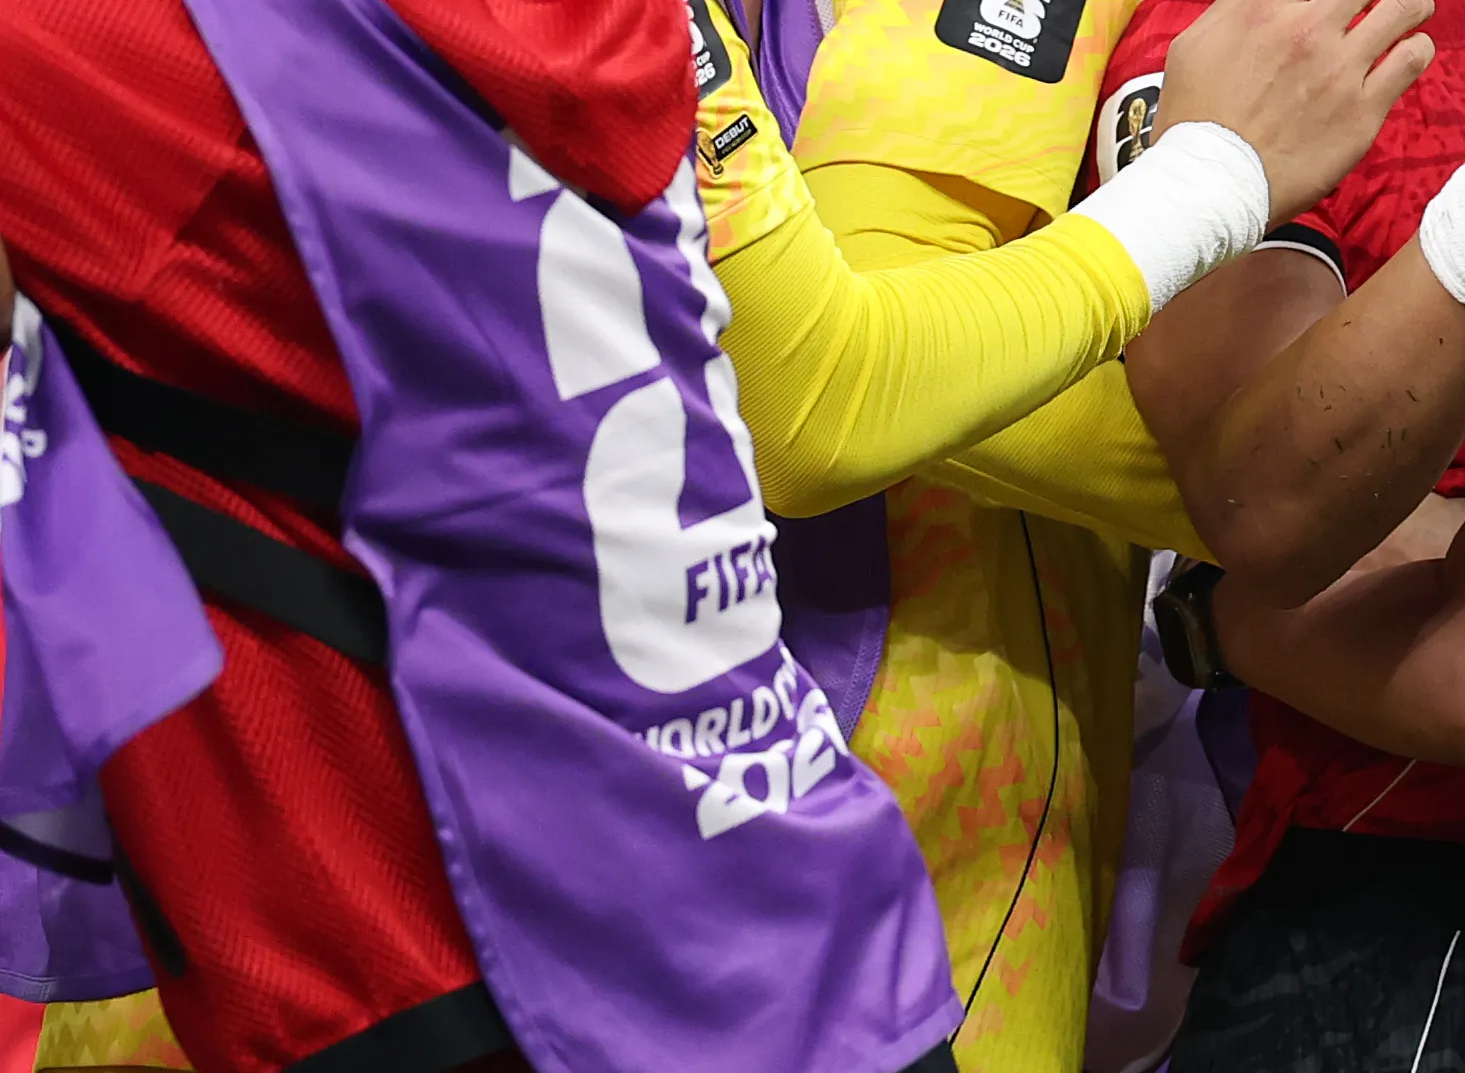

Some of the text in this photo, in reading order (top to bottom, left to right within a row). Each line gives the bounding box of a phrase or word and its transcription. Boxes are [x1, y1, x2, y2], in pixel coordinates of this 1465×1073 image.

[998, 9, 1025, 28] FIFA
[967, 31, 1032, 68] 2026
[973, 21, 1035, 54] WORLD CUP
[714, 117, 750, 149] DEBUT
[685, 534, 777, 625] FIFA
